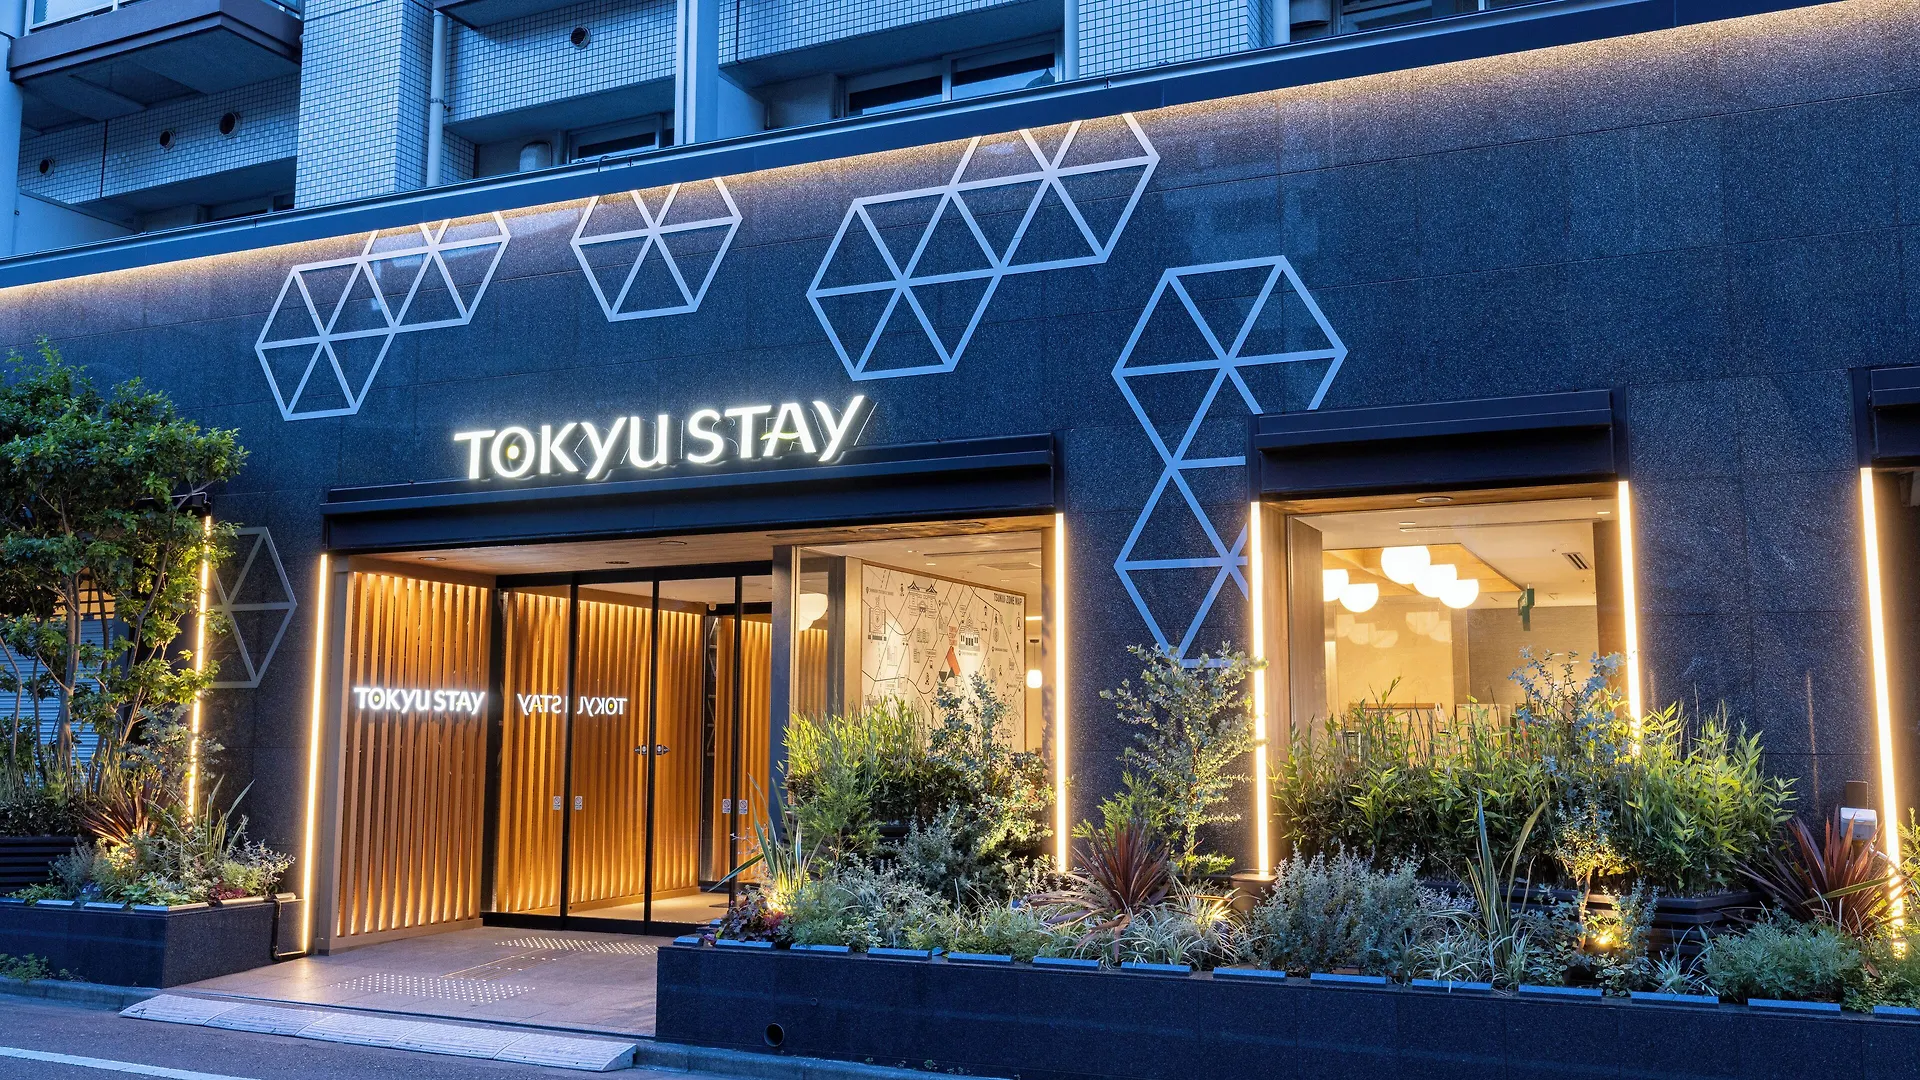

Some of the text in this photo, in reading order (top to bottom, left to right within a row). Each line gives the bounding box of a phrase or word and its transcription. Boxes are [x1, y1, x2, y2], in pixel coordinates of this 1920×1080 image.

[454, 395, 865, 480] TOKYU STAY
[354, 687, 485, 715] TOKYU STAY
